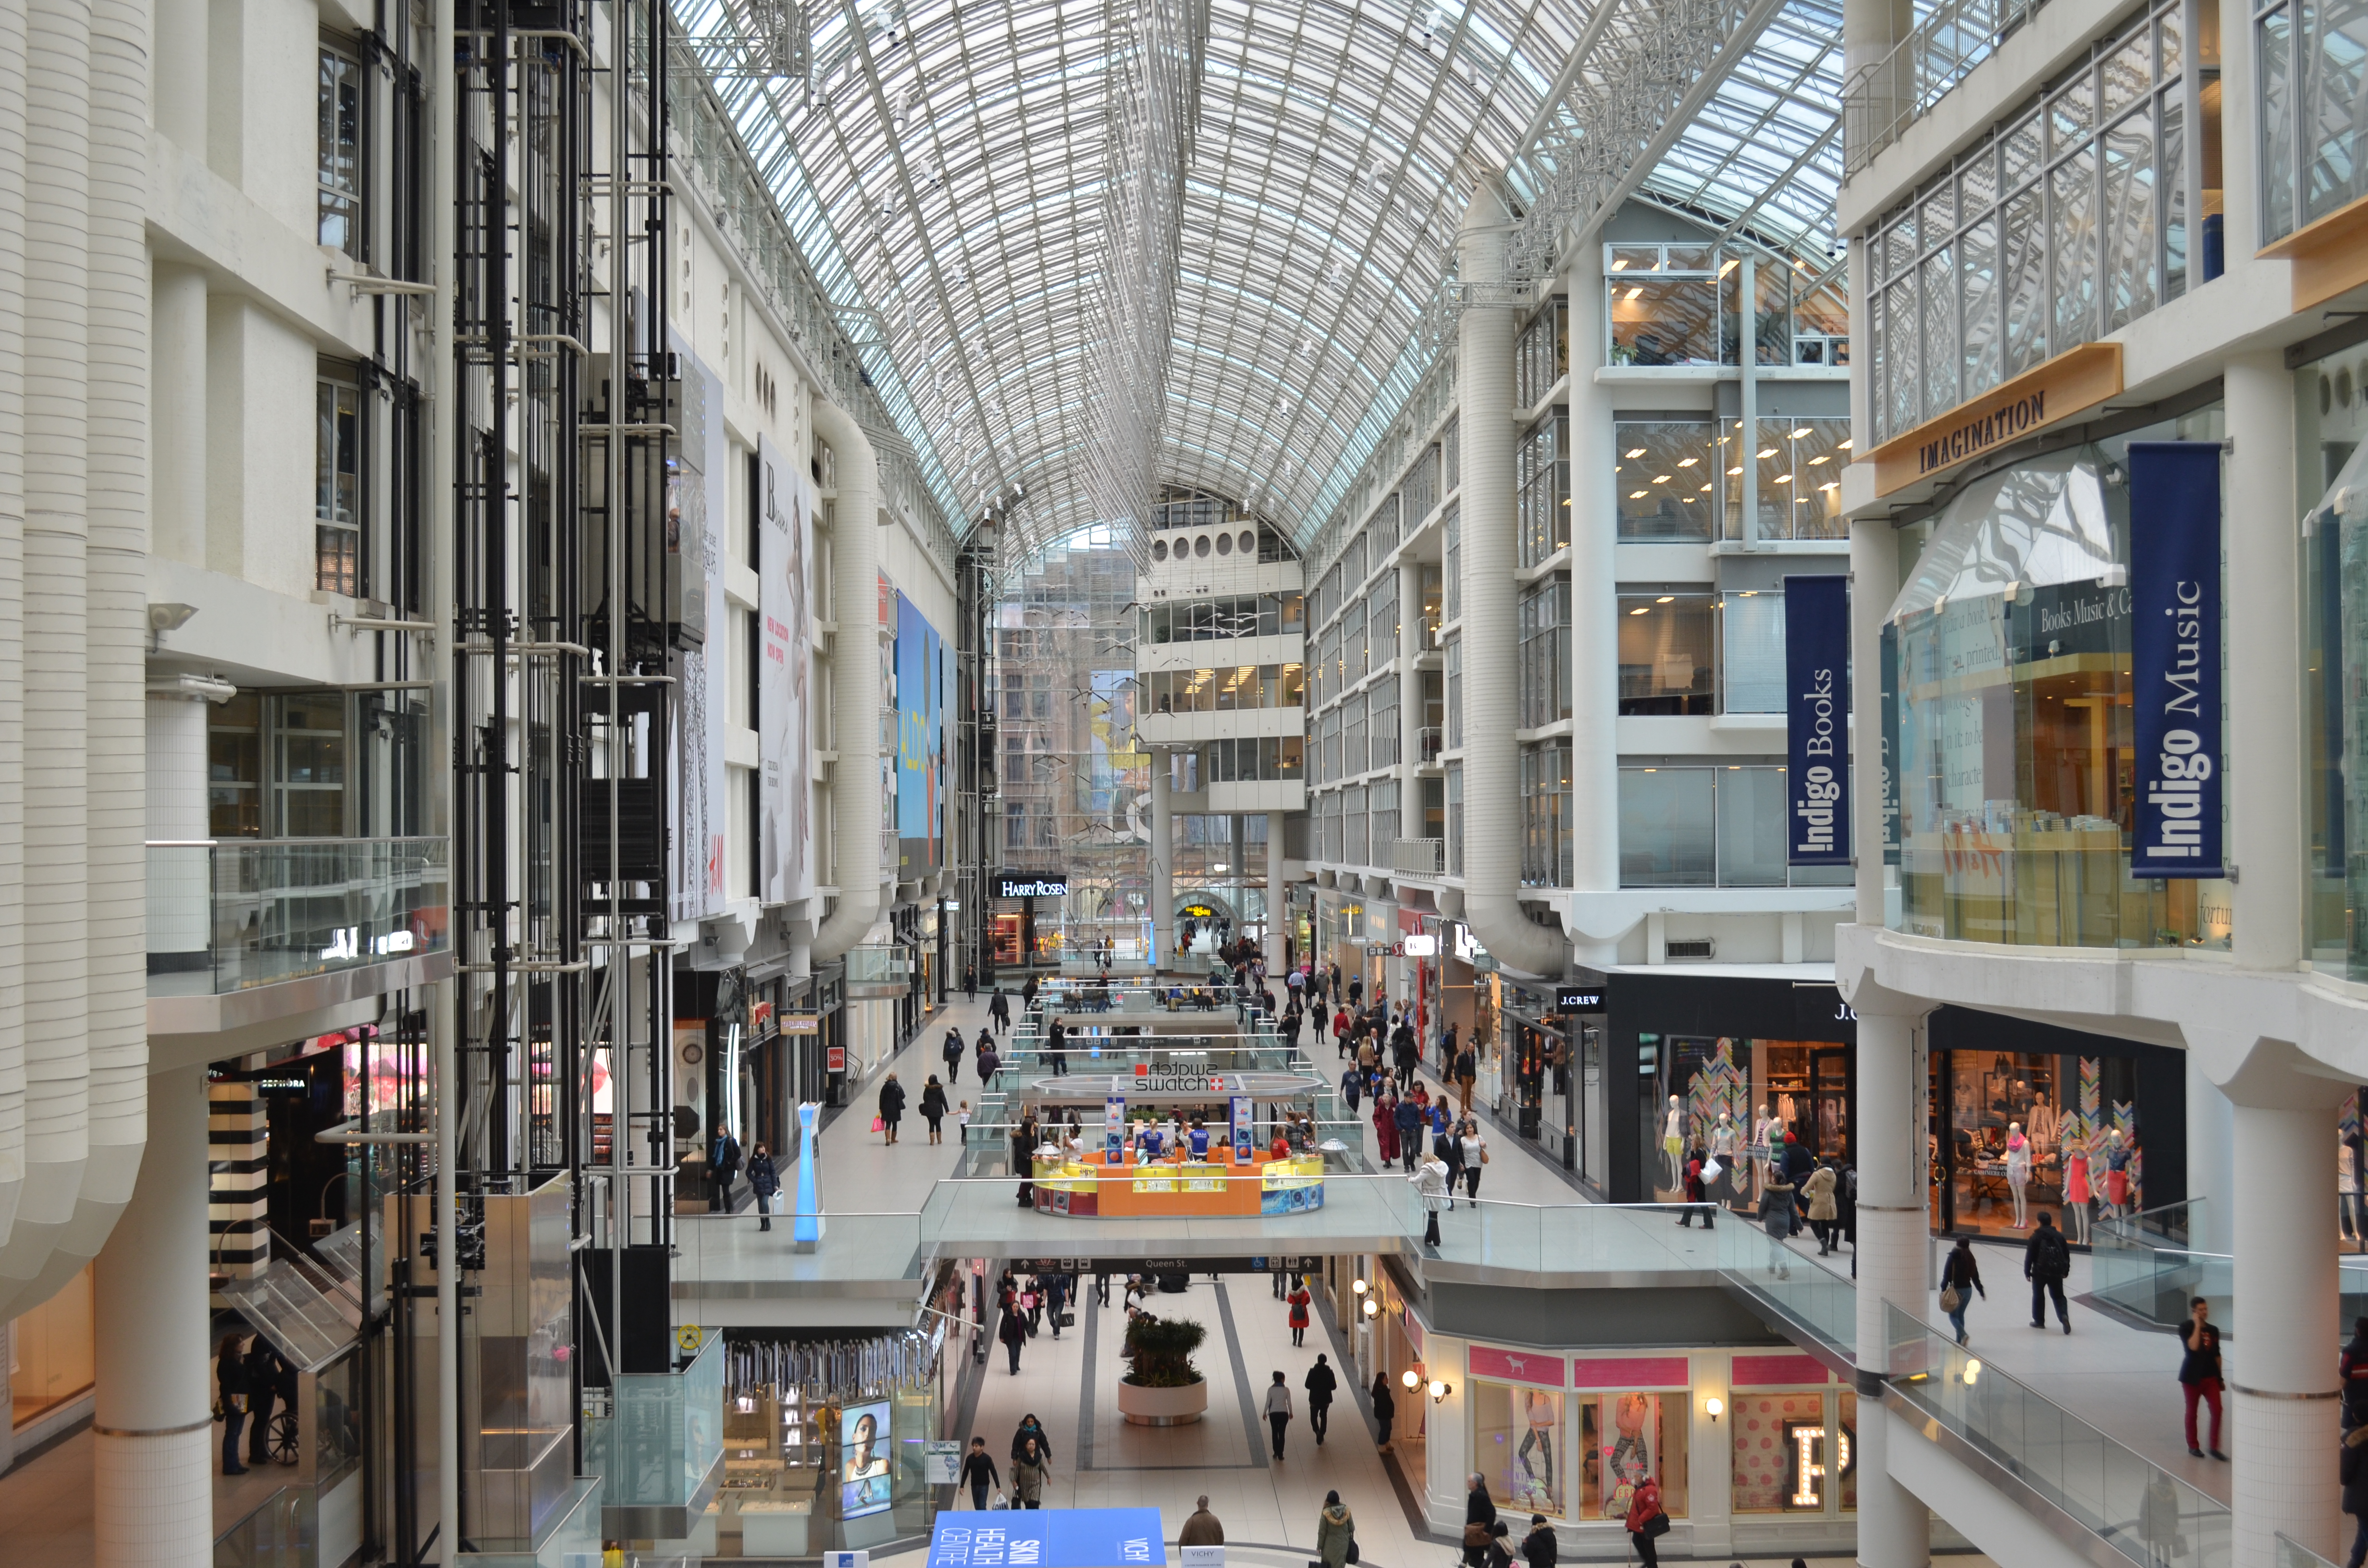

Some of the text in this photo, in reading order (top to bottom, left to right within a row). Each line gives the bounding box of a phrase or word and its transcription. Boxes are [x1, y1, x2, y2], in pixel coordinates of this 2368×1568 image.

[1919, 391, 2045, 474] IMAGINATION
[1967, 600, 1986, 627] book.
[2041, 601, 2071, 632] Books
[2073, 596, 2104, 625] Music
[775, 620, 789, 643] LOCATION
[776, 646, 784, 665] OPEN
[1967, 635, 2001, 674] printed,
[2165, 581, 2200, 717] Music
[1803, 669, 1832, 757] Books
[900, 707, 926, 775] ALDO
[1965, 730, 1972, 745] to
[709, 833, 723, 896] H&M
[1002, 881, 1068, 896] HARRY ROSEN
[1561, 996, 1599, 1005] J.CREW
[1135, 1075, 1209, 1091] swatch
[1146, 1260, 1174, 1268] Queen
[936, 1528, 972, 1565] CENTRE
[972, 1528, 1005, 1565] HEALTH
[1009, 1539, 1040, 1564] SKIN
[1124, 1537, 1150, 1561] VICHY
